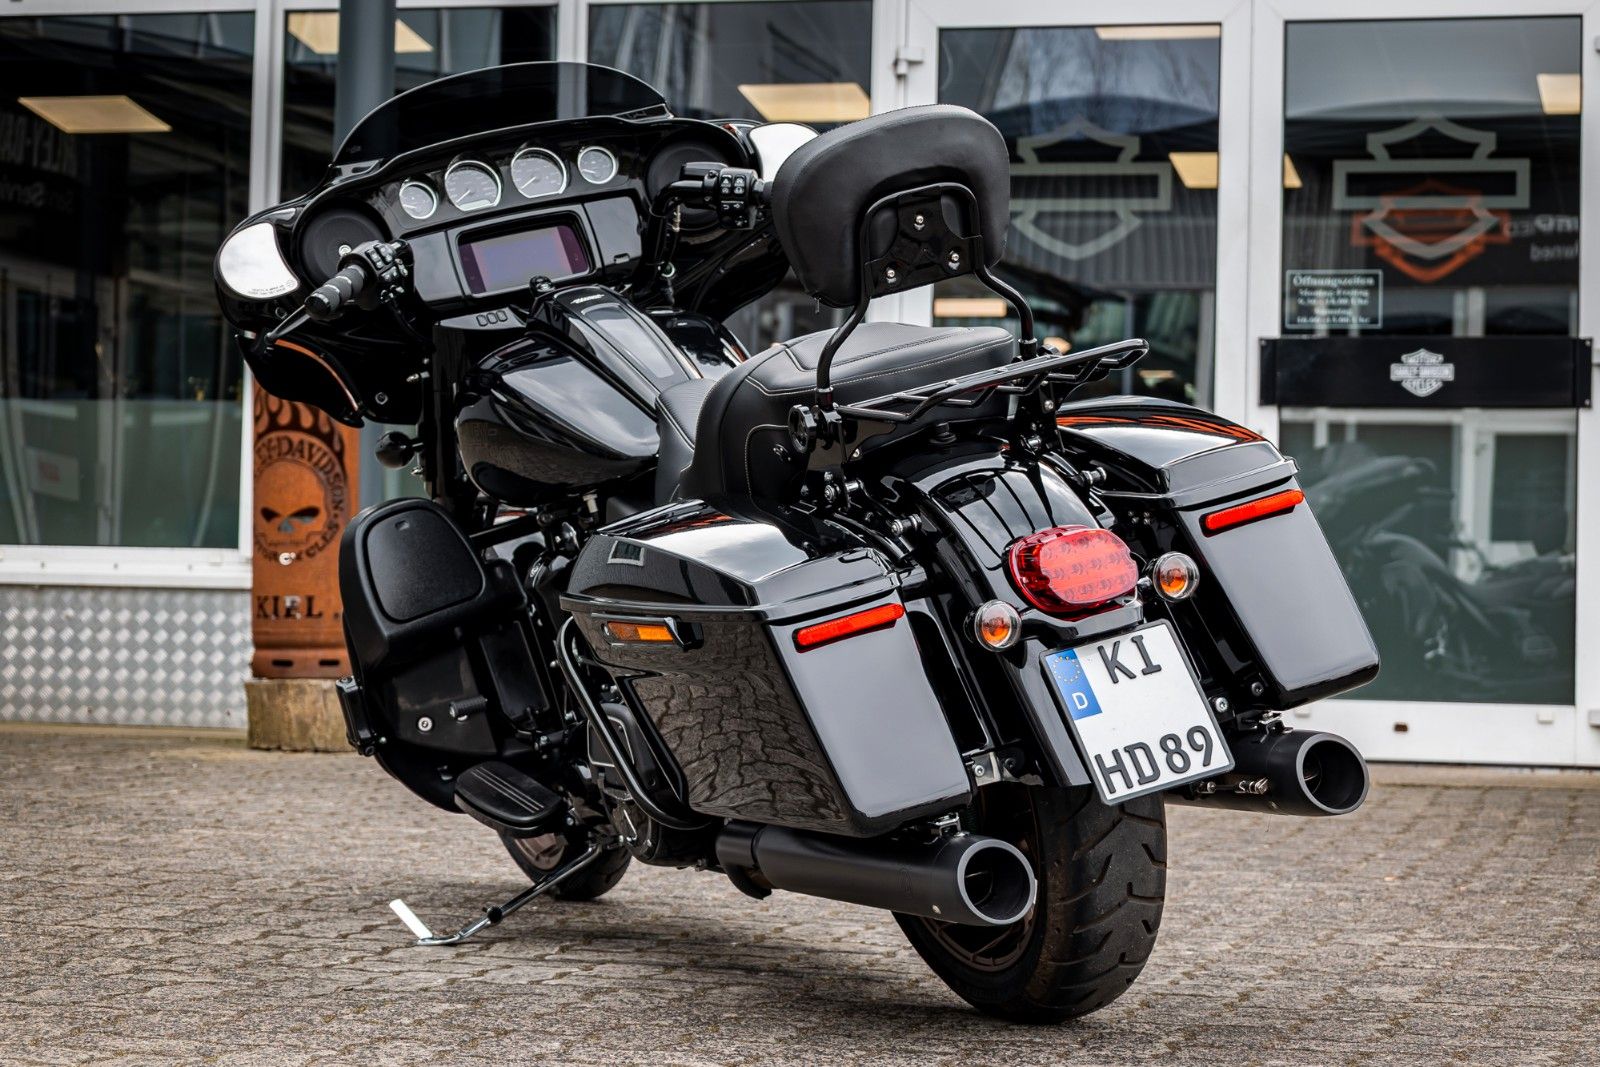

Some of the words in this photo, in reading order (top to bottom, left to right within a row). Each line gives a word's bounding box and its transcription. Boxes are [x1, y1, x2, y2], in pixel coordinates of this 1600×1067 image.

[256, 595, 323, 619] KIEL
[1097, 634, 1162, 684] KI
[1071, 691, 1089, 710] D
